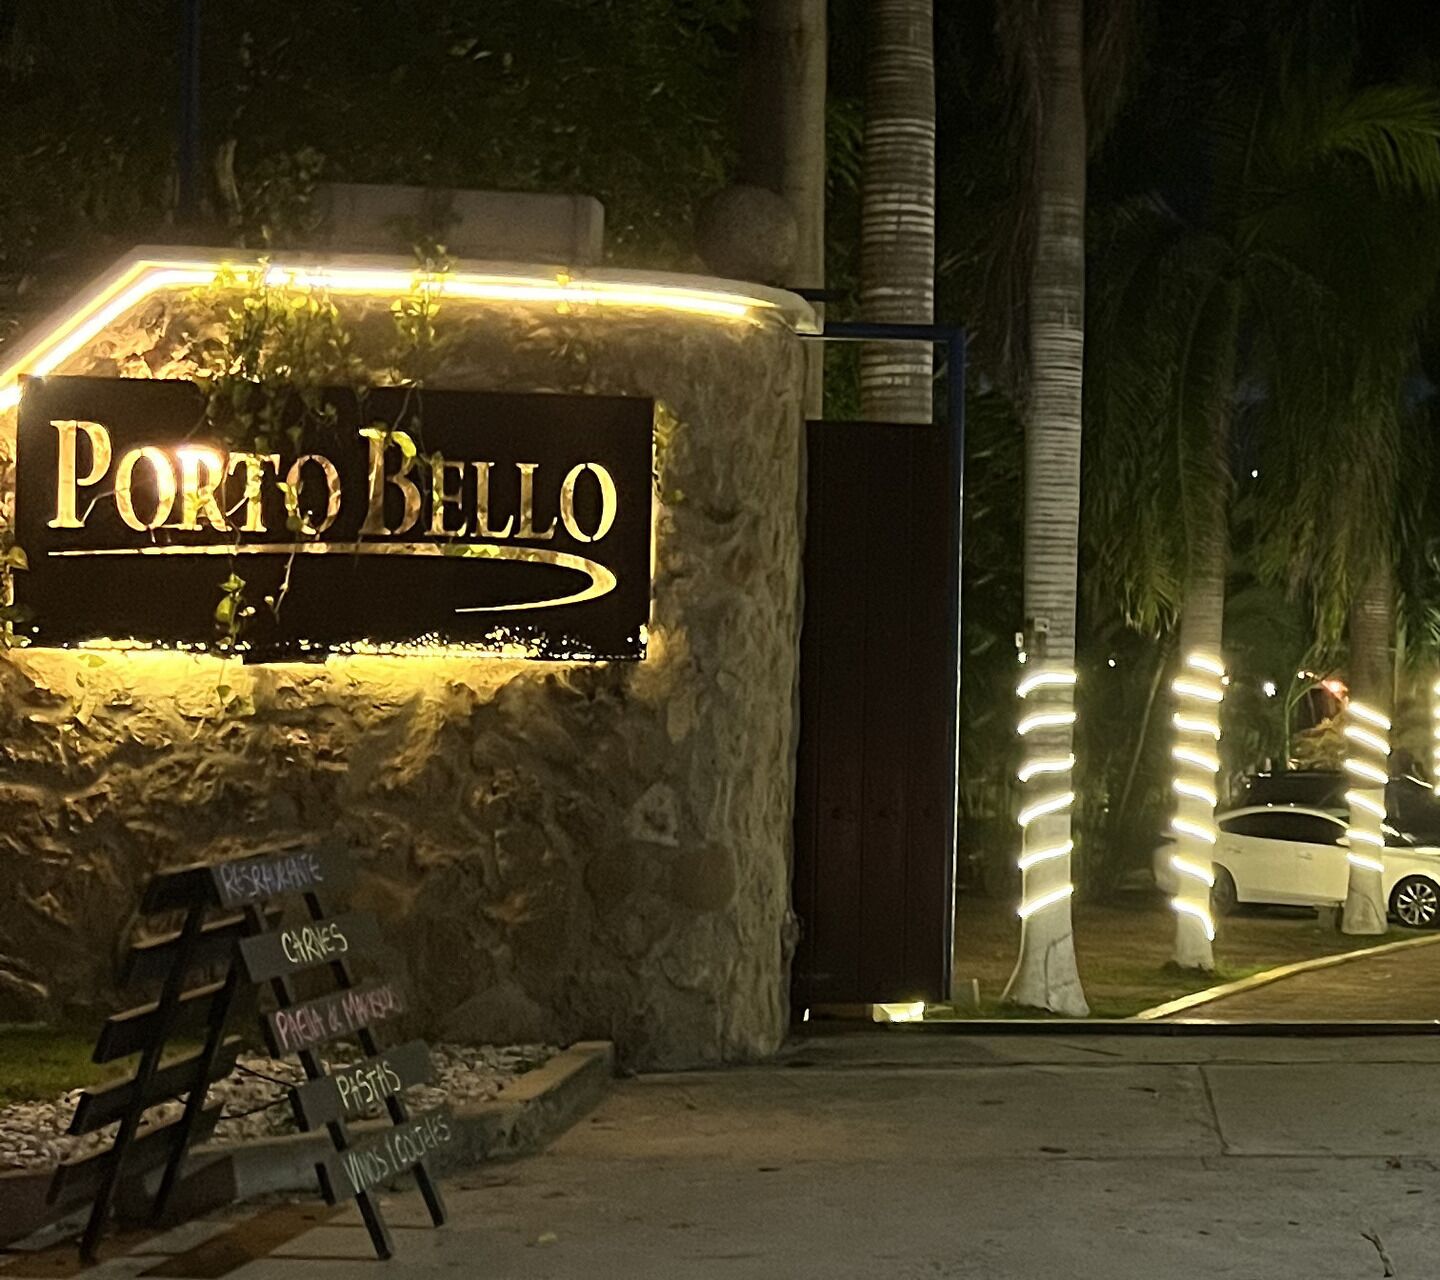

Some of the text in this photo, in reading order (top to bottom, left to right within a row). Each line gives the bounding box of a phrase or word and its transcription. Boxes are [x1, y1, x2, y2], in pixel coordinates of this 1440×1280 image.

[47, 419, 618, 543] PORTO BELLO
[281, 922, 349, 963] CARNES
[335, 1060, 401, 1111] PASTAS
